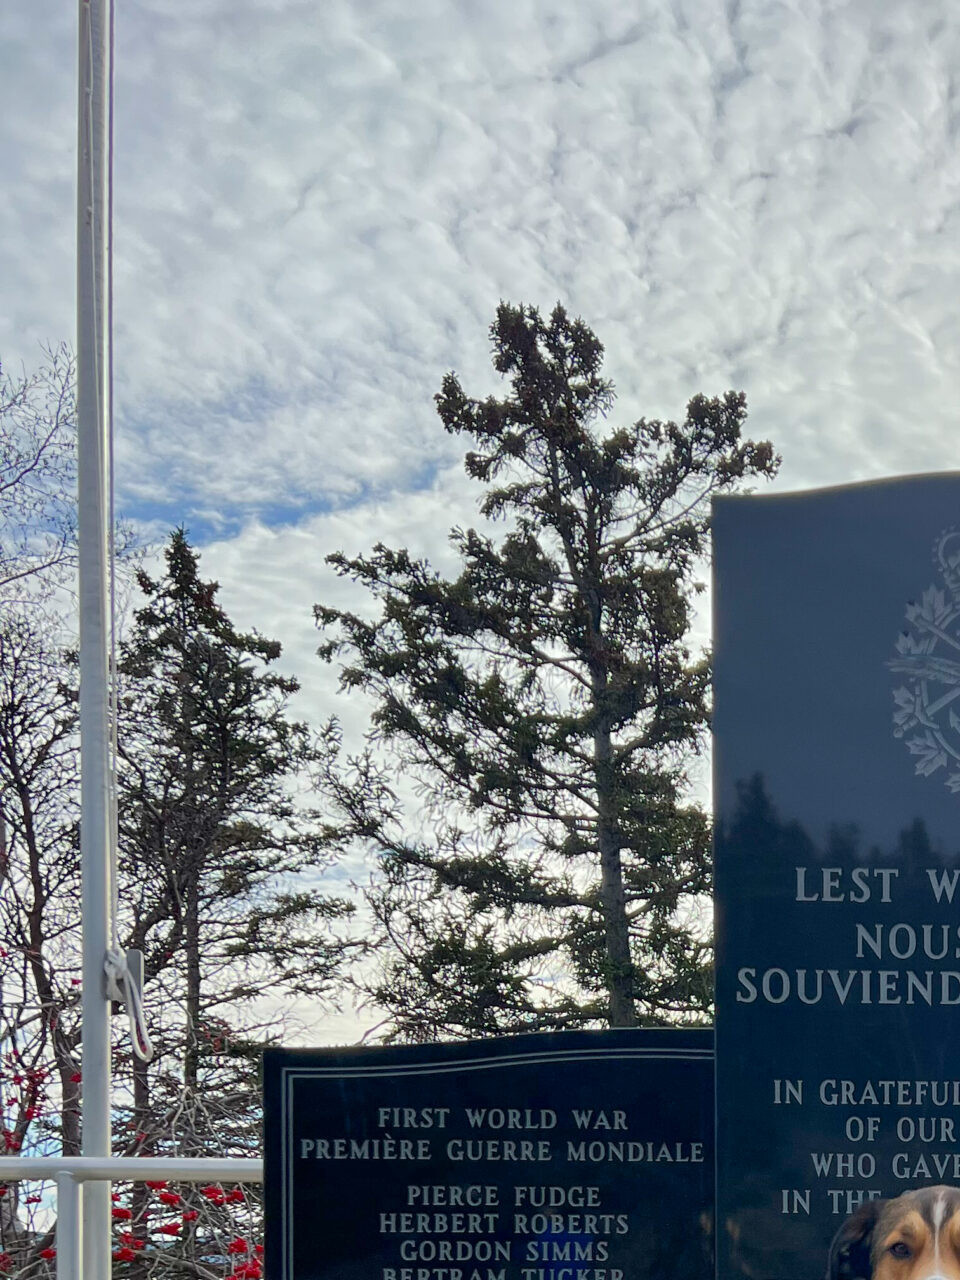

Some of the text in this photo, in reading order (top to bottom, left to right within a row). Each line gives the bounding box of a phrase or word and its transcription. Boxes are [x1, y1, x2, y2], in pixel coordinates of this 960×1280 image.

[794, 866, 900, 904] LEST
[773, 1079, 804, 1105] IN
[377, 1107, 629, 1131] FIRST WORLD WAR
[844, 1116, 882, 1142] OF
[895, 1116, 958, 1143] OUR
[299, 1133, 705, 1163] PREMIÈRE GUERRE MONDIALE
[810, 1152, 876, 1178] WHO
[406, 1185, 602, 1208] PIERCE FUDGE
[780, 1189, 812, 1214] IN
[378, 1213, 630, 1235] HERBERT ROBERTS
[399, 1240, 610, 1262] GORDON SIMMS
